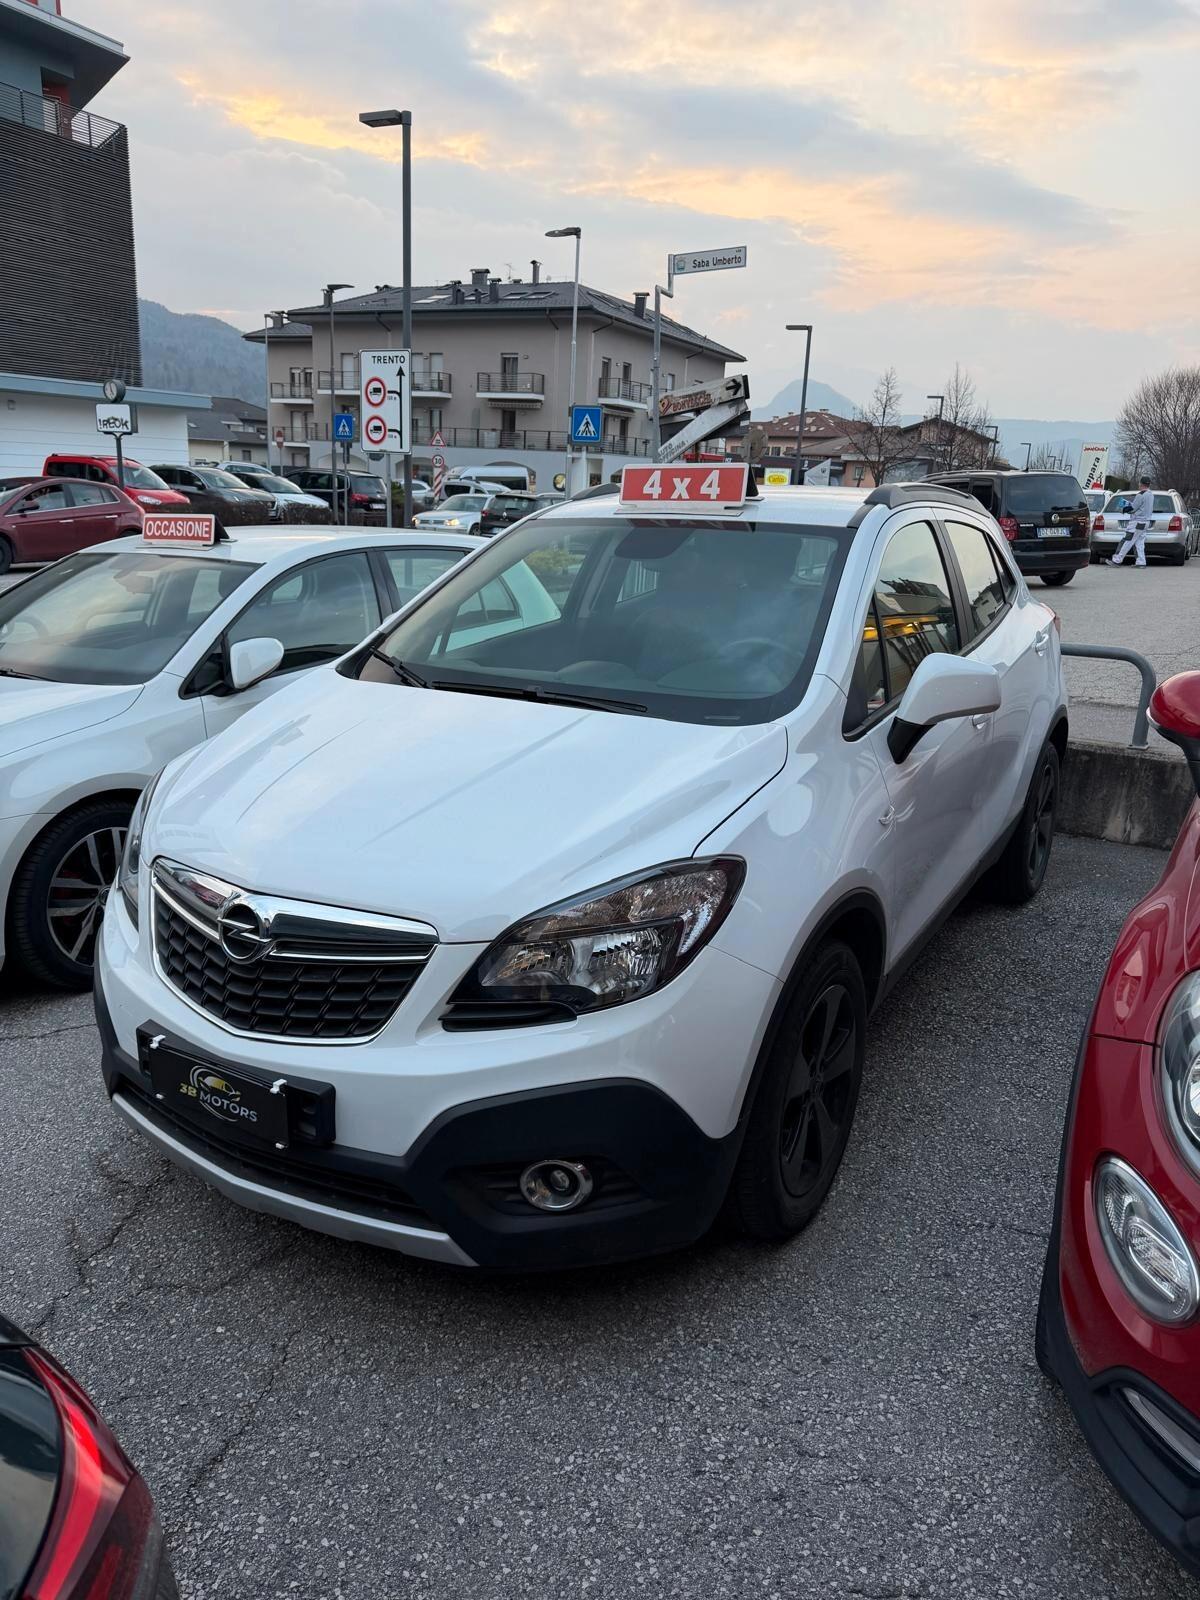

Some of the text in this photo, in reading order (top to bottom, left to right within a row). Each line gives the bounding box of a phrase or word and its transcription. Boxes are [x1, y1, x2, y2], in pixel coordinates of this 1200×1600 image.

[692, 254, 742, 269] Saba Umberto
[371, 355, 406, 364] TRENTO
[642, 469, 720, 500] 4 x 4
[145, 521, 210, 538] OCCASIONE
[179, 1083, 258, 1122] 3B MOTORS
